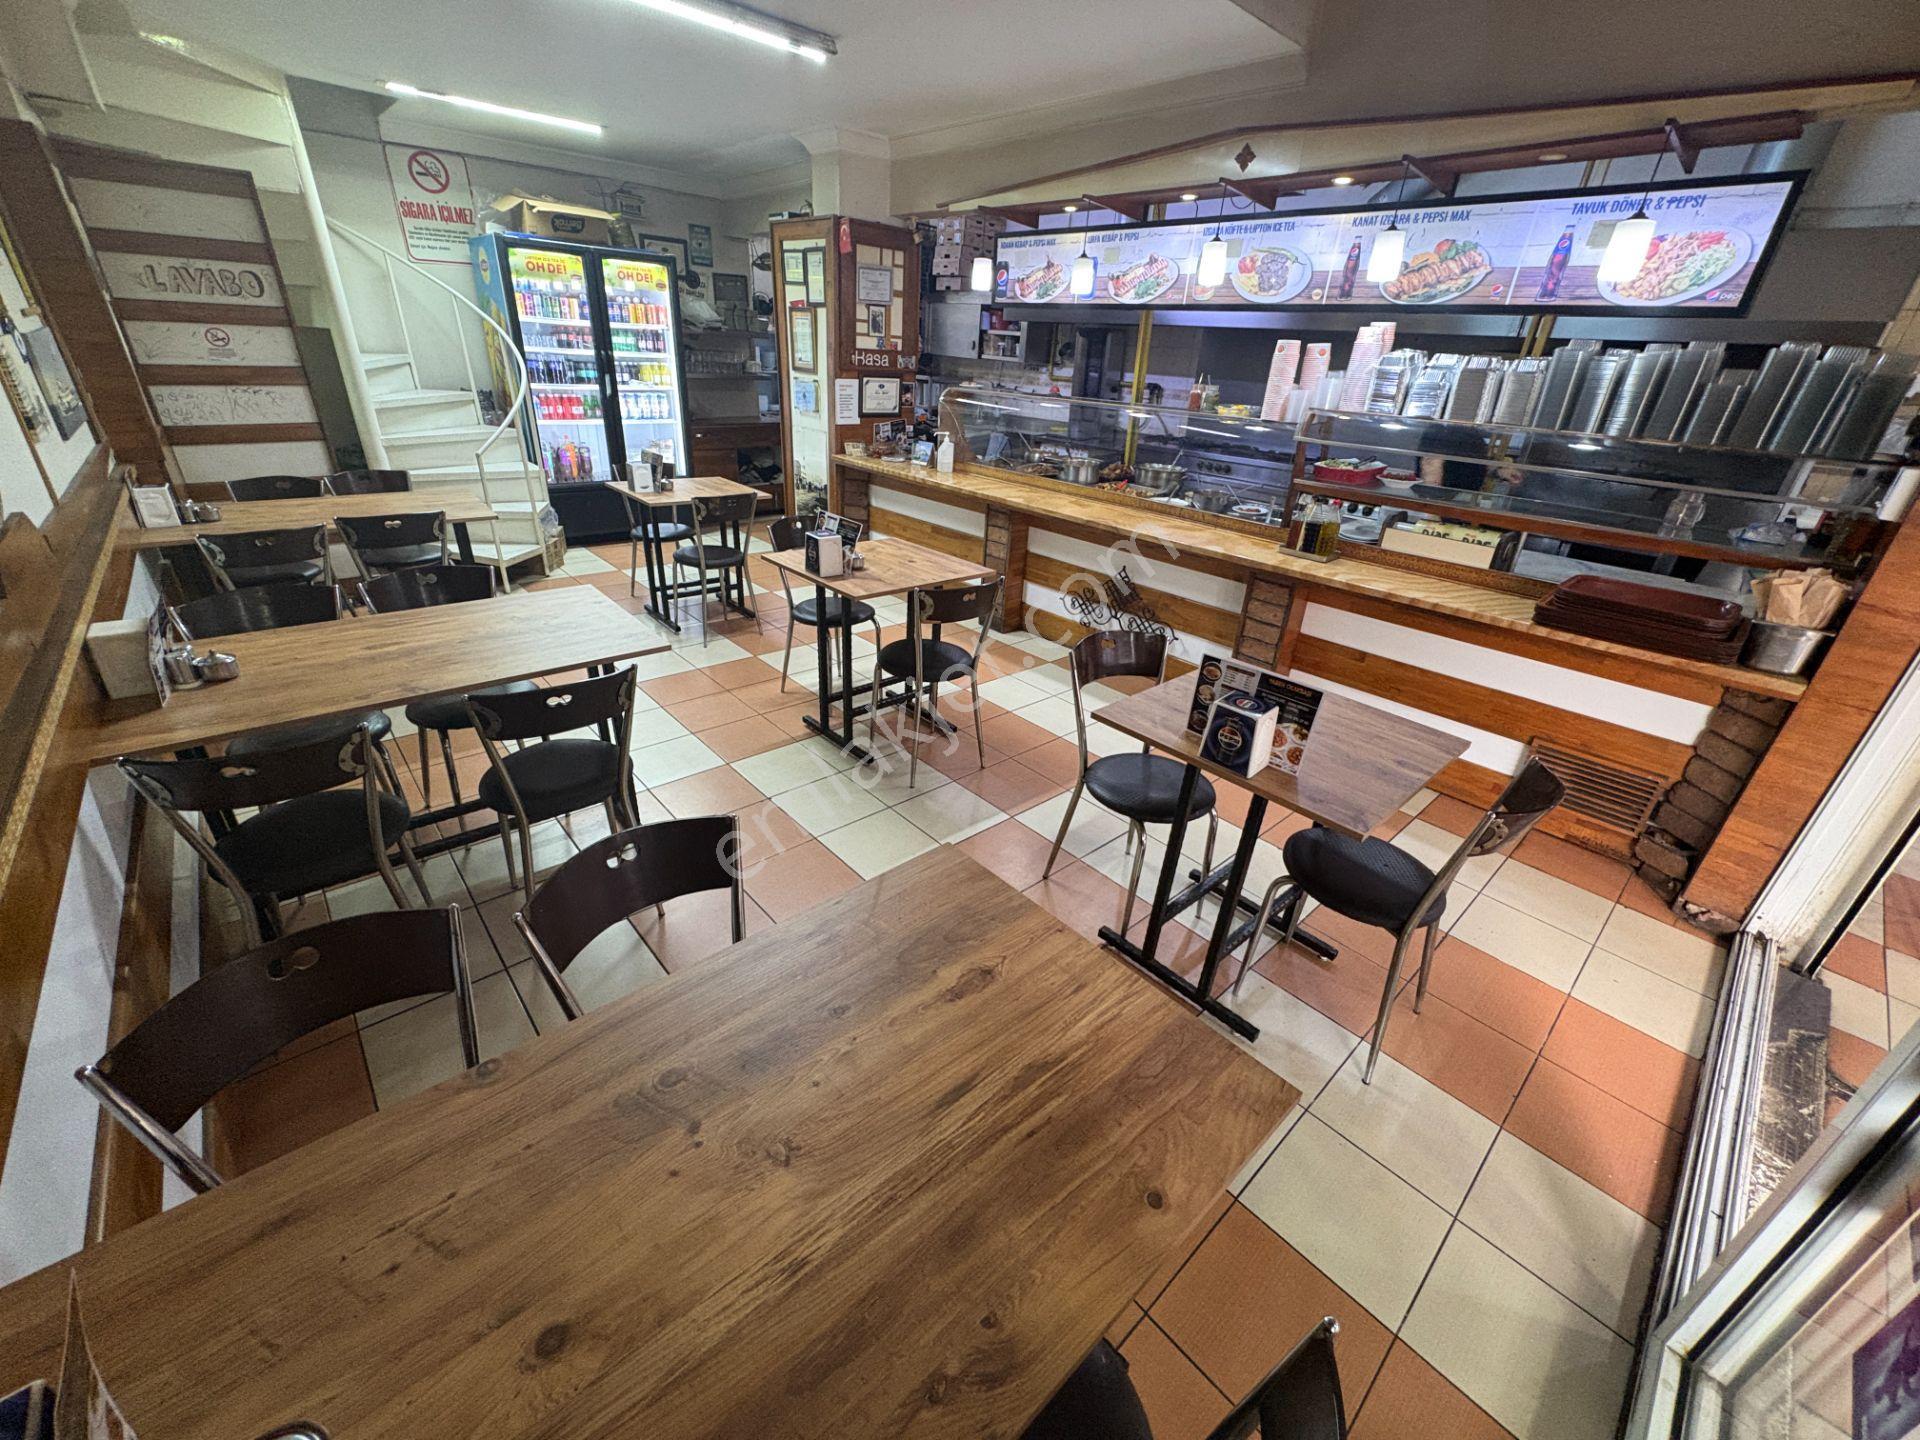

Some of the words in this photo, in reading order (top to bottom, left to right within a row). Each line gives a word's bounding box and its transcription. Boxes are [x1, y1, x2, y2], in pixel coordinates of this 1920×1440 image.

[400, 196, 437, 221] SİGARA
[437, 201, 475, 225] İÇİLMEZ
[1572, 201, 1609, 215] TAVUK
[1654, 196, 1665, 210] &
[1666, 194, 1706, 210] PEPSI
[1352, 216, 1379, 227] KANAT
[1413, 212, 1420, 224] &
[1421, 210, 1449, 223] PEPSI
[1451, 209, 1472, 221] MAX
[1249, 222, 1271, 234] LIPTON
[1284, 221, 1297, 231] TEA
[525, 260, 545, 273] OH
[547, 262, 567, 275] DE!
[617, 270, 634, 281] OH
[636, 271, 654, 283] DE!
[143, 264, 265, 298] LAVABO
